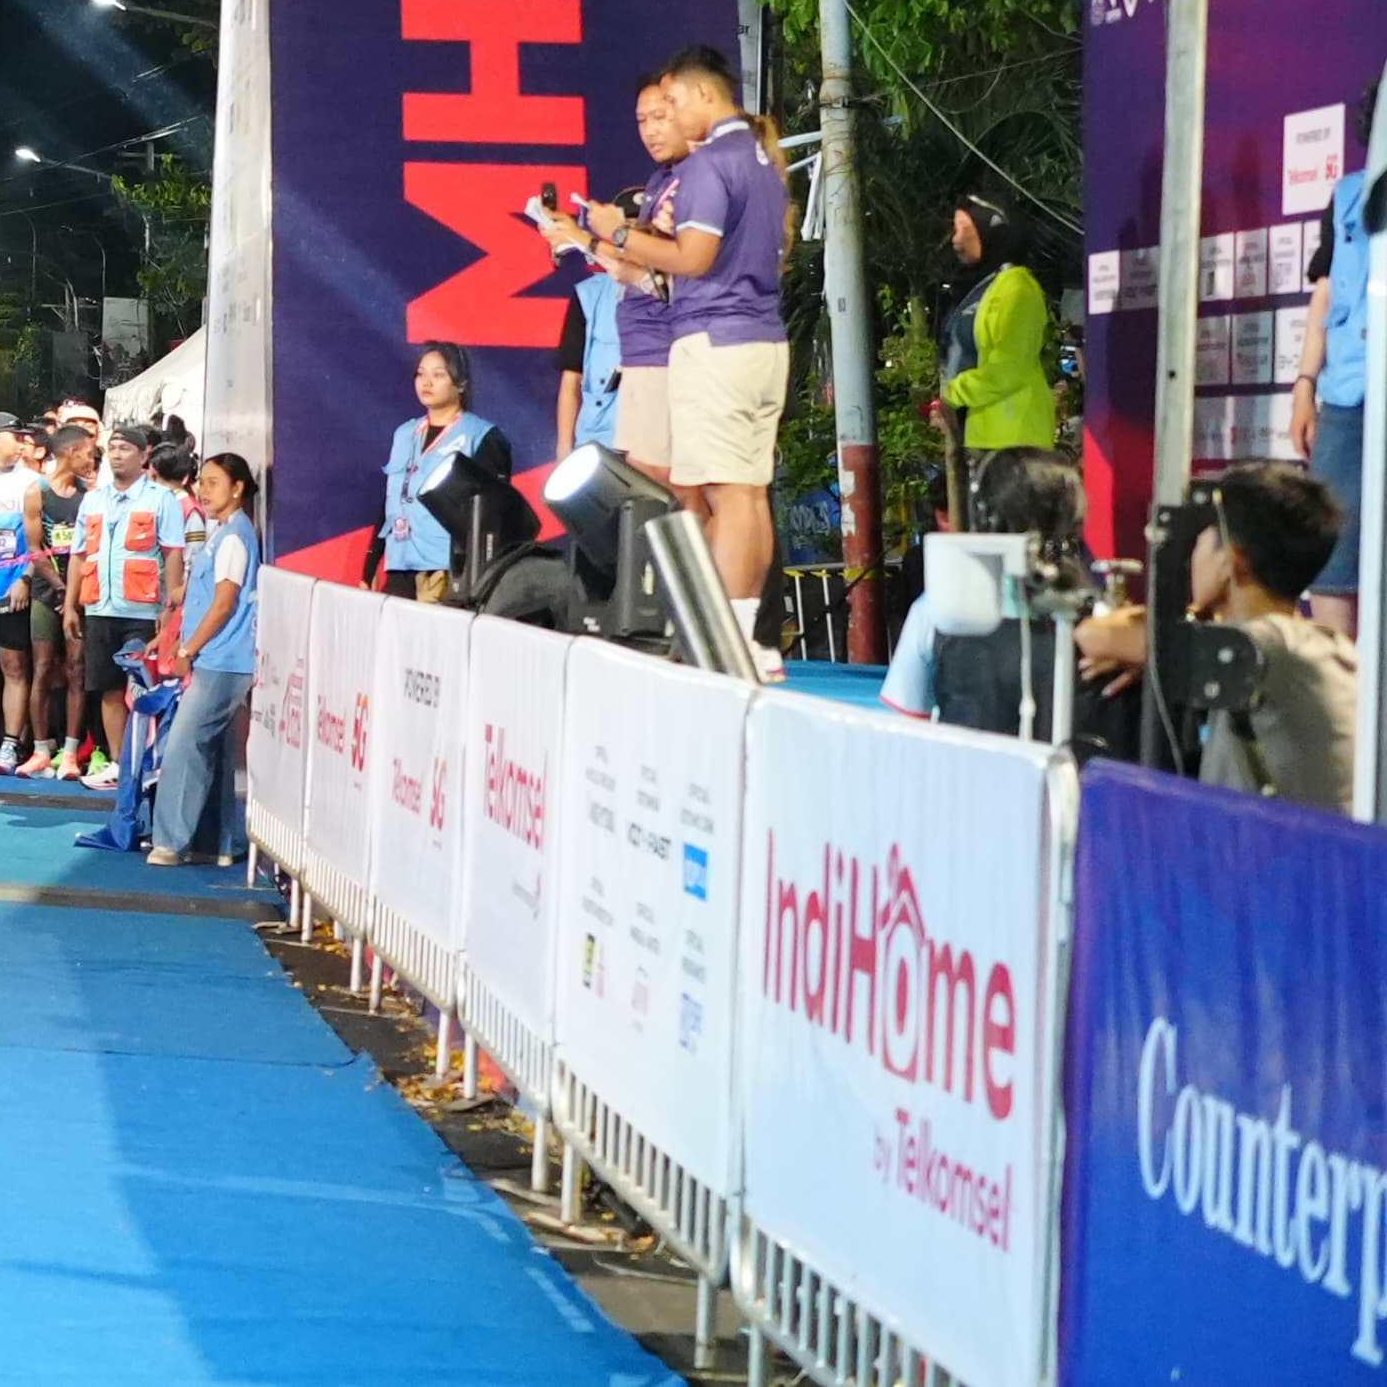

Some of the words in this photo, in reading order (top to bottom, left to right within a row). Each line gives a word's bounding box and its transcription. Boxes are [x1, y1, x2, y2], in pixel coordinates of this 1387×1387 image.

[484, 723, 548, 854] Telkomsel
[762, 827, 1018, 1121] IndiHome
[873, 1133, 893, 1186] by
[894, 1108, 1012, 1253] Telkomsel
